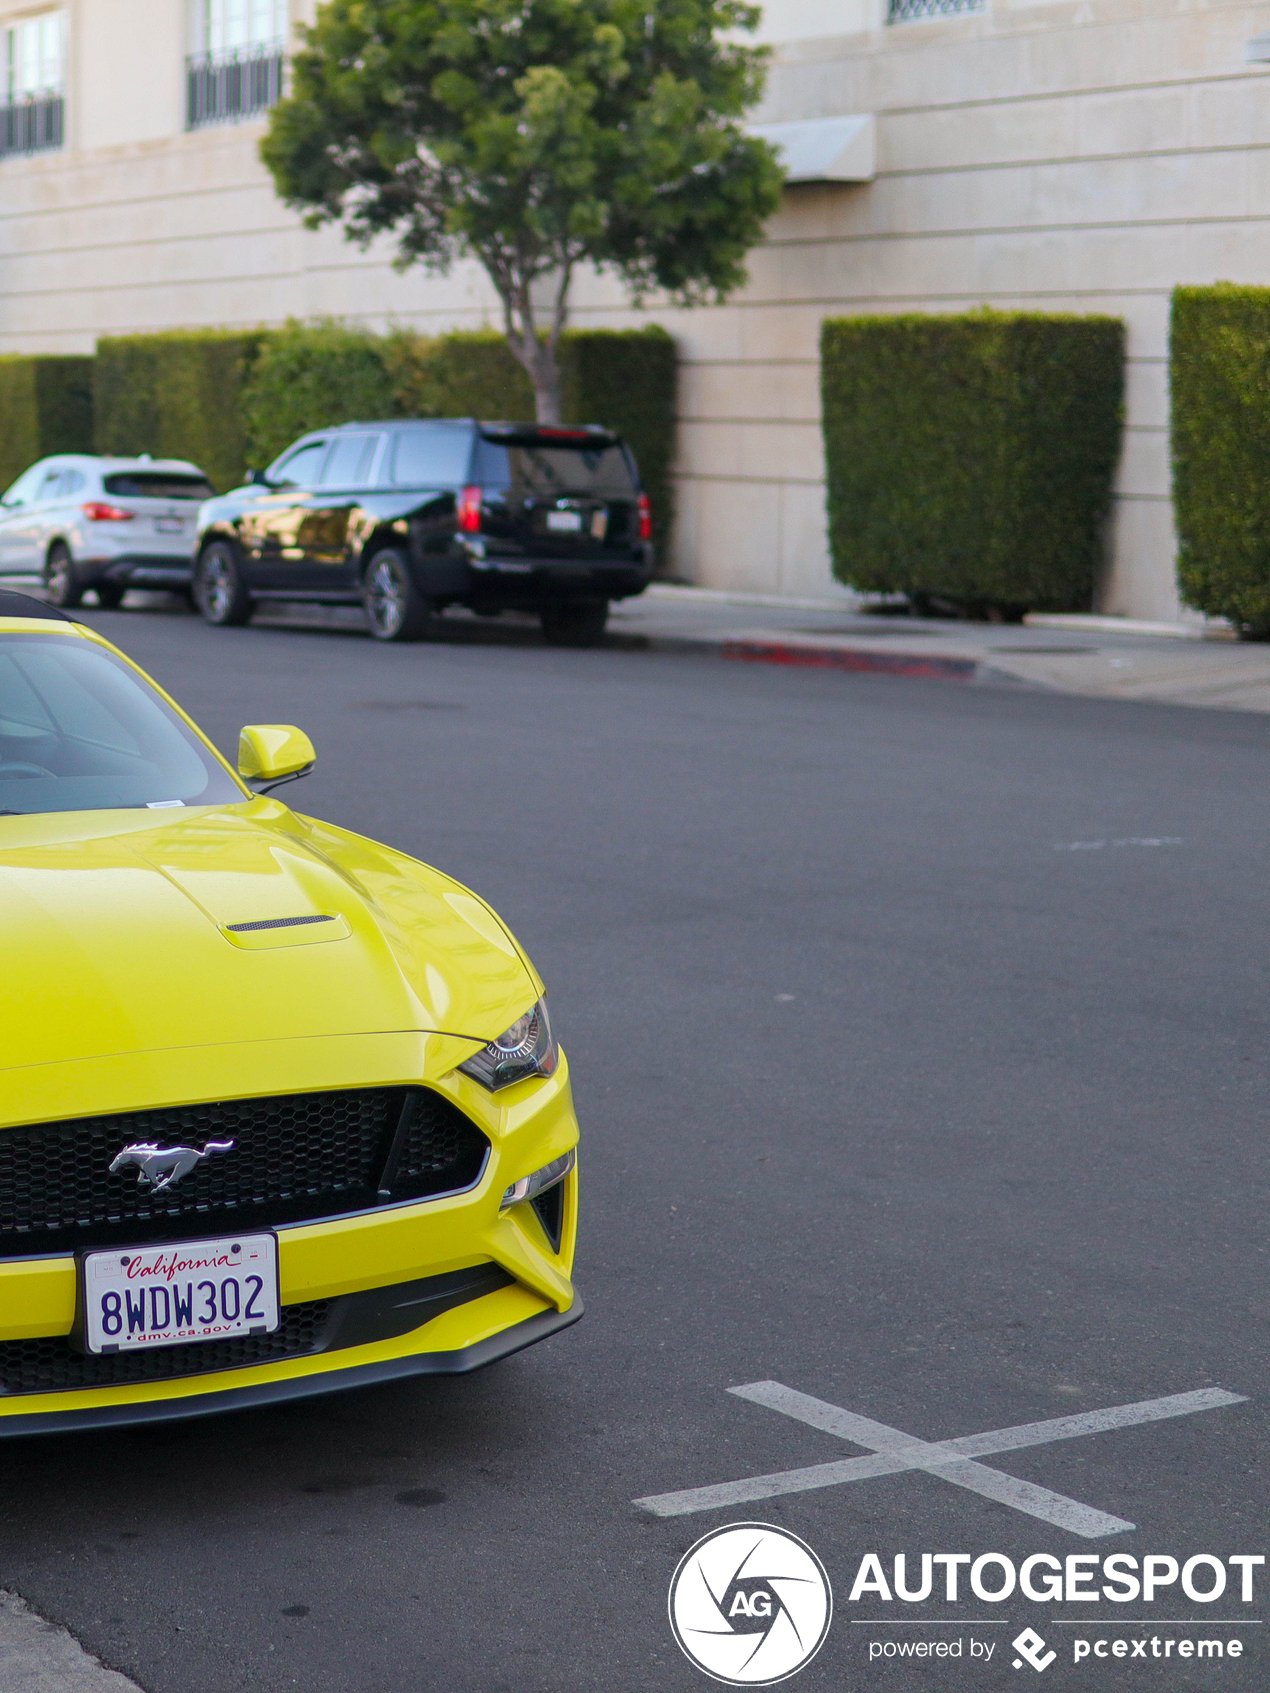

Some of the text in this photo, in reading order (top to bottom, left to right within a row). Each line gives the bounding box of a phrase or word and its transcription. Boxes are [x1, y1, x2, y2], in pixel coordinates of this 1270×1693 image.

[126, 1250, 242, 1281] California
[100, 1274, 265, 1336] 8WDW302
[137, 1324, 232, 1341] dmv.ca.gov
